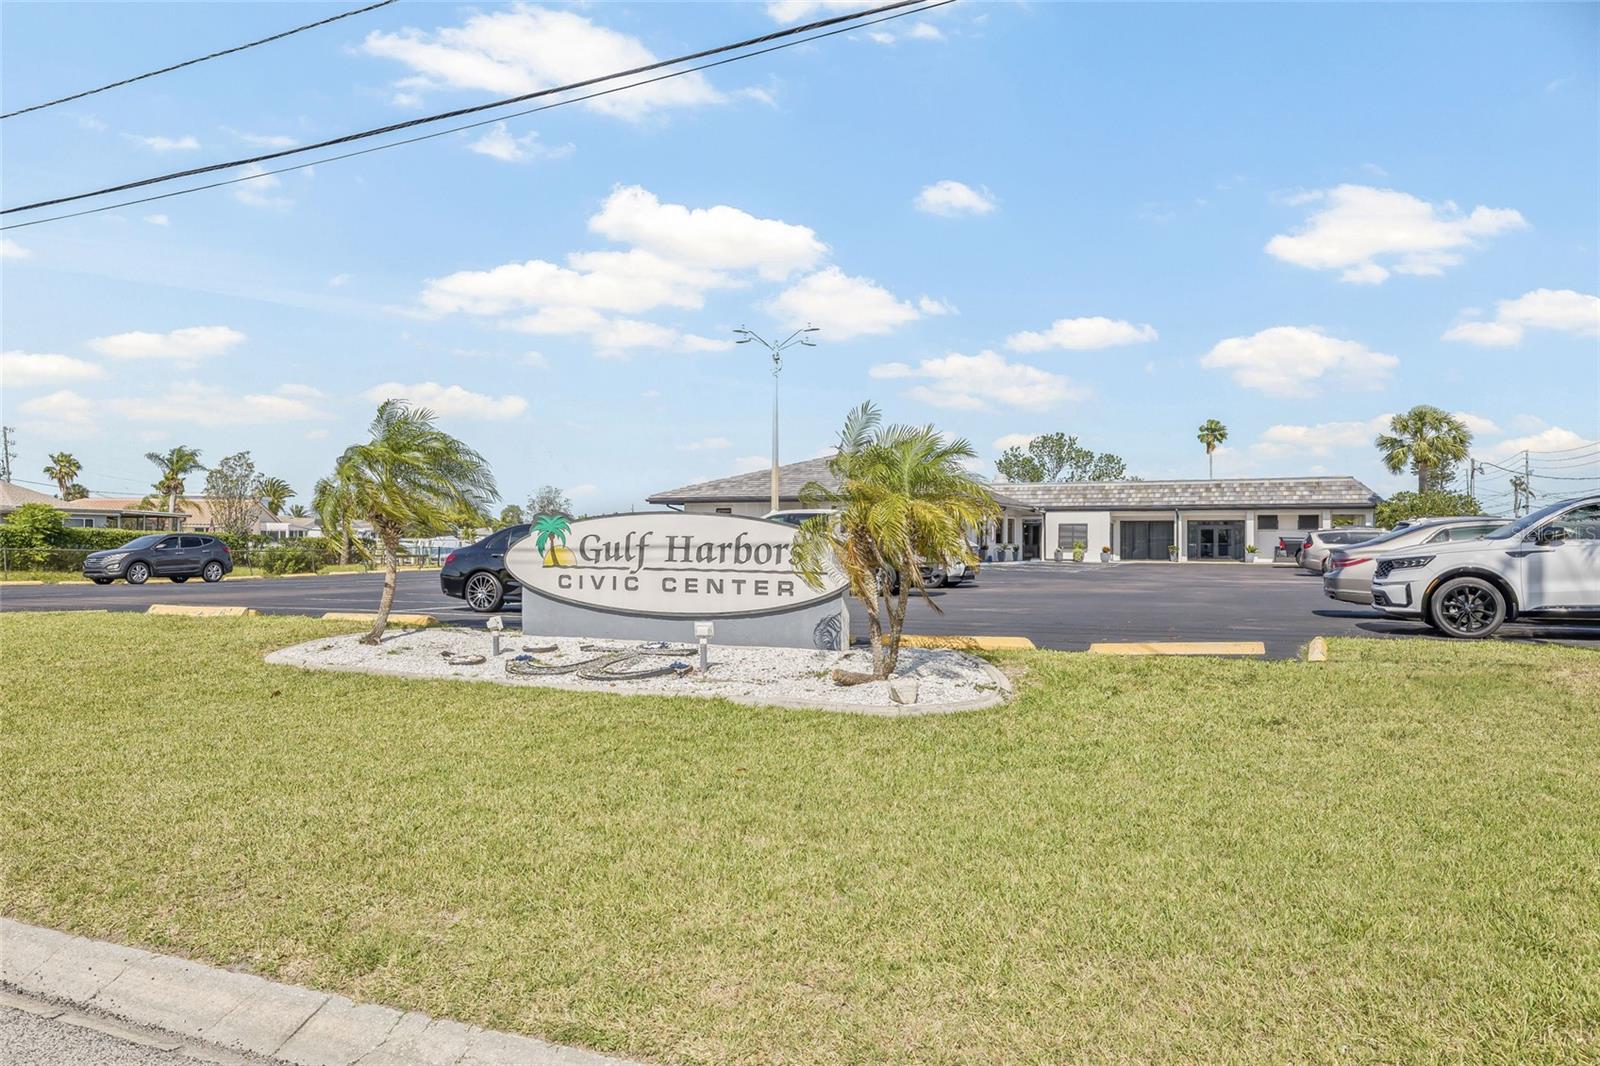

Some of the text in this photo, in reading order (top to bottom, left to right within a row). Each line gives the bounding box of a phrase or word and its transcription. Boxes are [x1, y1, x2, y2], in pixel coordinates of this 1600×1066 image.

[579, 531, 653, 574] Gulf
[558, 574, 794, 597] CIVIC CENTER
